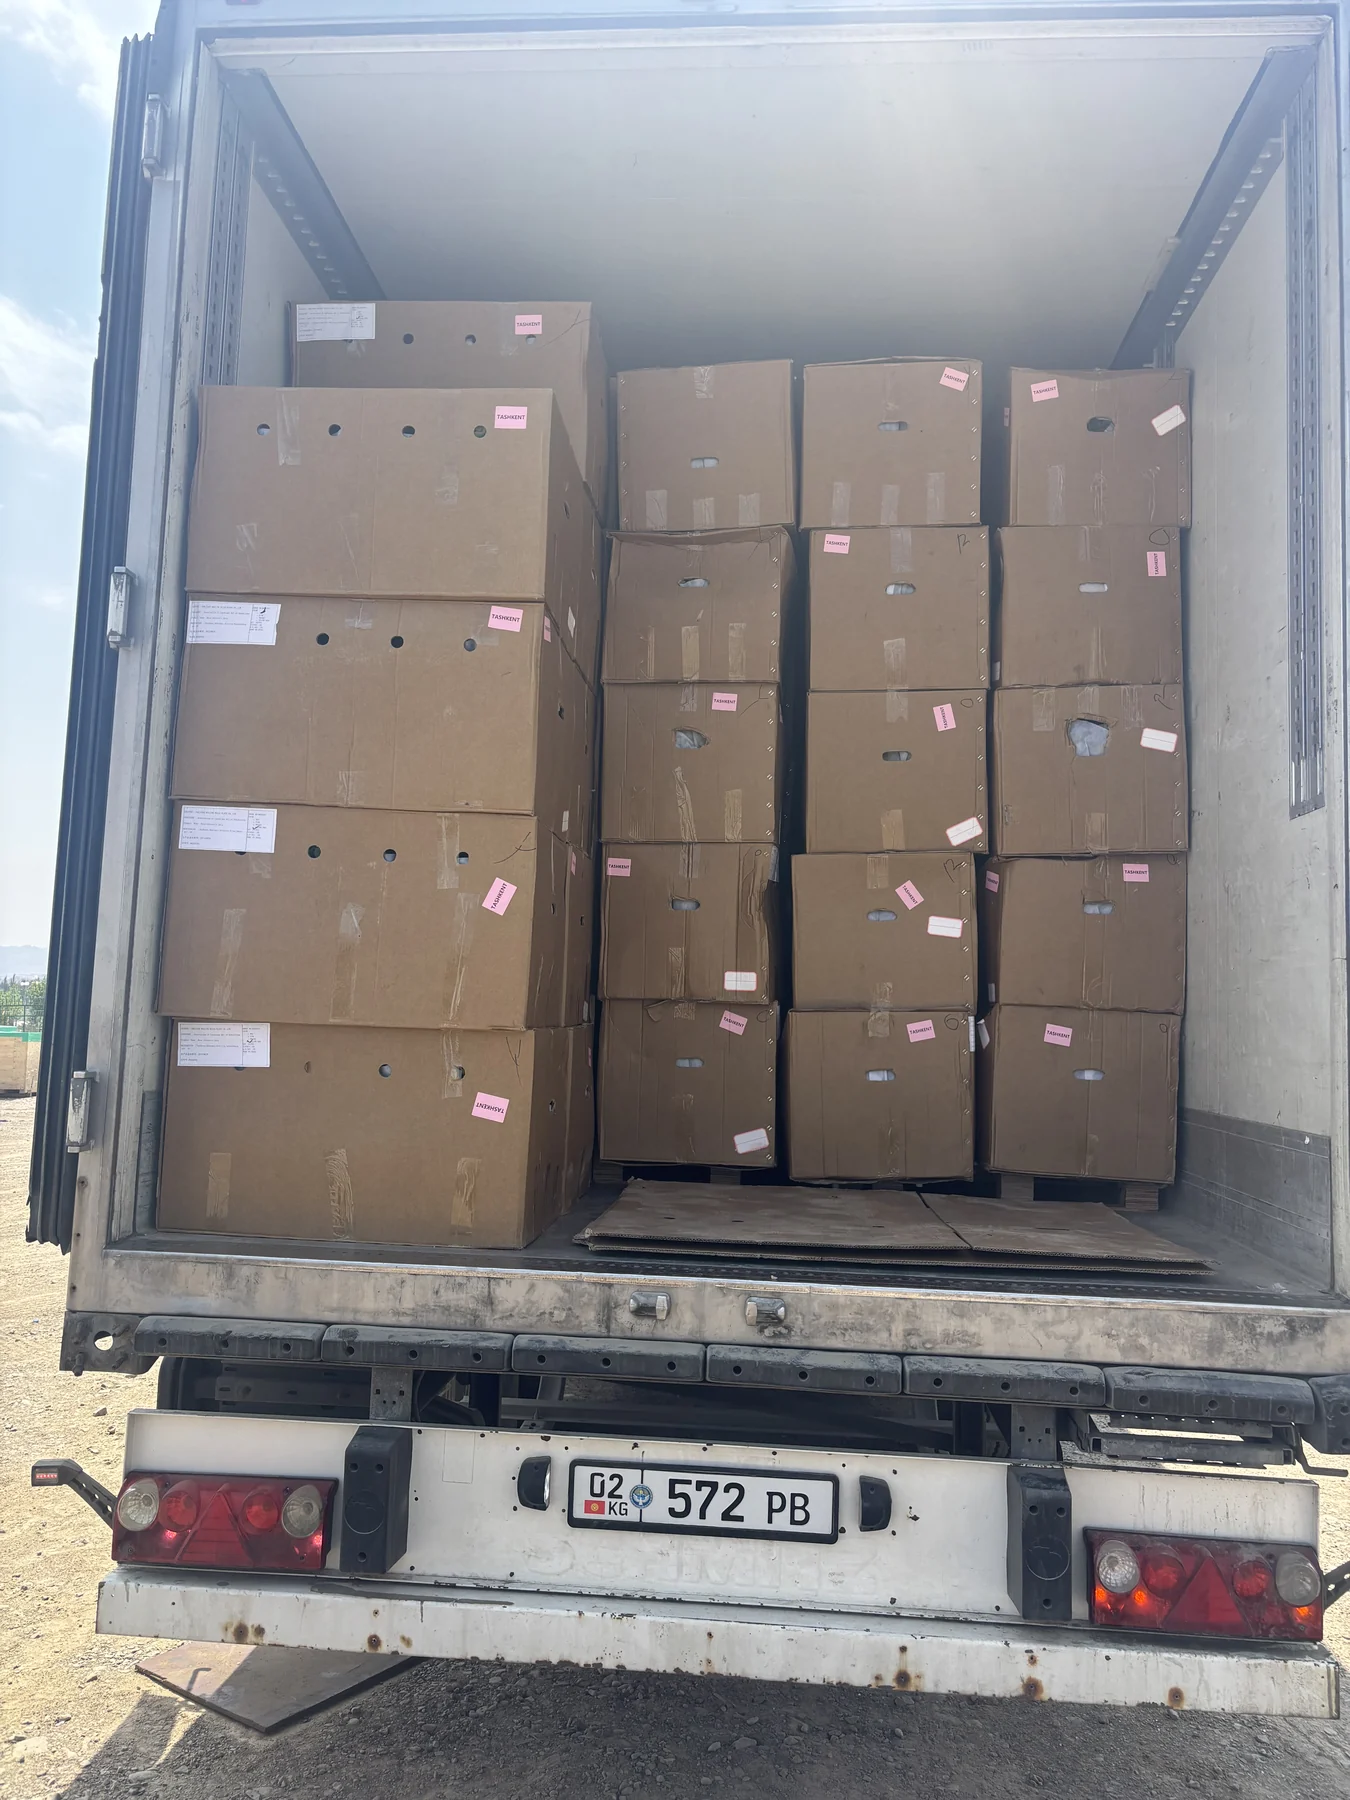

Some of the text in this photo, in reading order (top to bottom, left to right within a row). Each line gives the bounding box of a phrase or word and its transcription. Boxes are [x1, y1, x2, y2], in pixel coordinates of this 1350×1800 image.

[944, 373, 966, 384] TASHKENT
[1033, 386, 1057, 395] TASHKENT
[491, 613, 520, 623] TASHKENT
[491, 883, 508, 910] TASHKENT
[902, 885, 918, 905] TASHKENT
[723, 1016, 745, 1028] TASHKENT
[909, 1026, 932, 1035] TASHKENT
[1046, 1030, 1070, 1039] TASHKENT
[476, 1102, 505, 1114] TASHKENT
[590, 1472, 623, 1499] 02
[668, 1478, 745, 1522] 572
[766, 1491, 810, 1526] PB
[608, 1501, 629, 1517] KG
